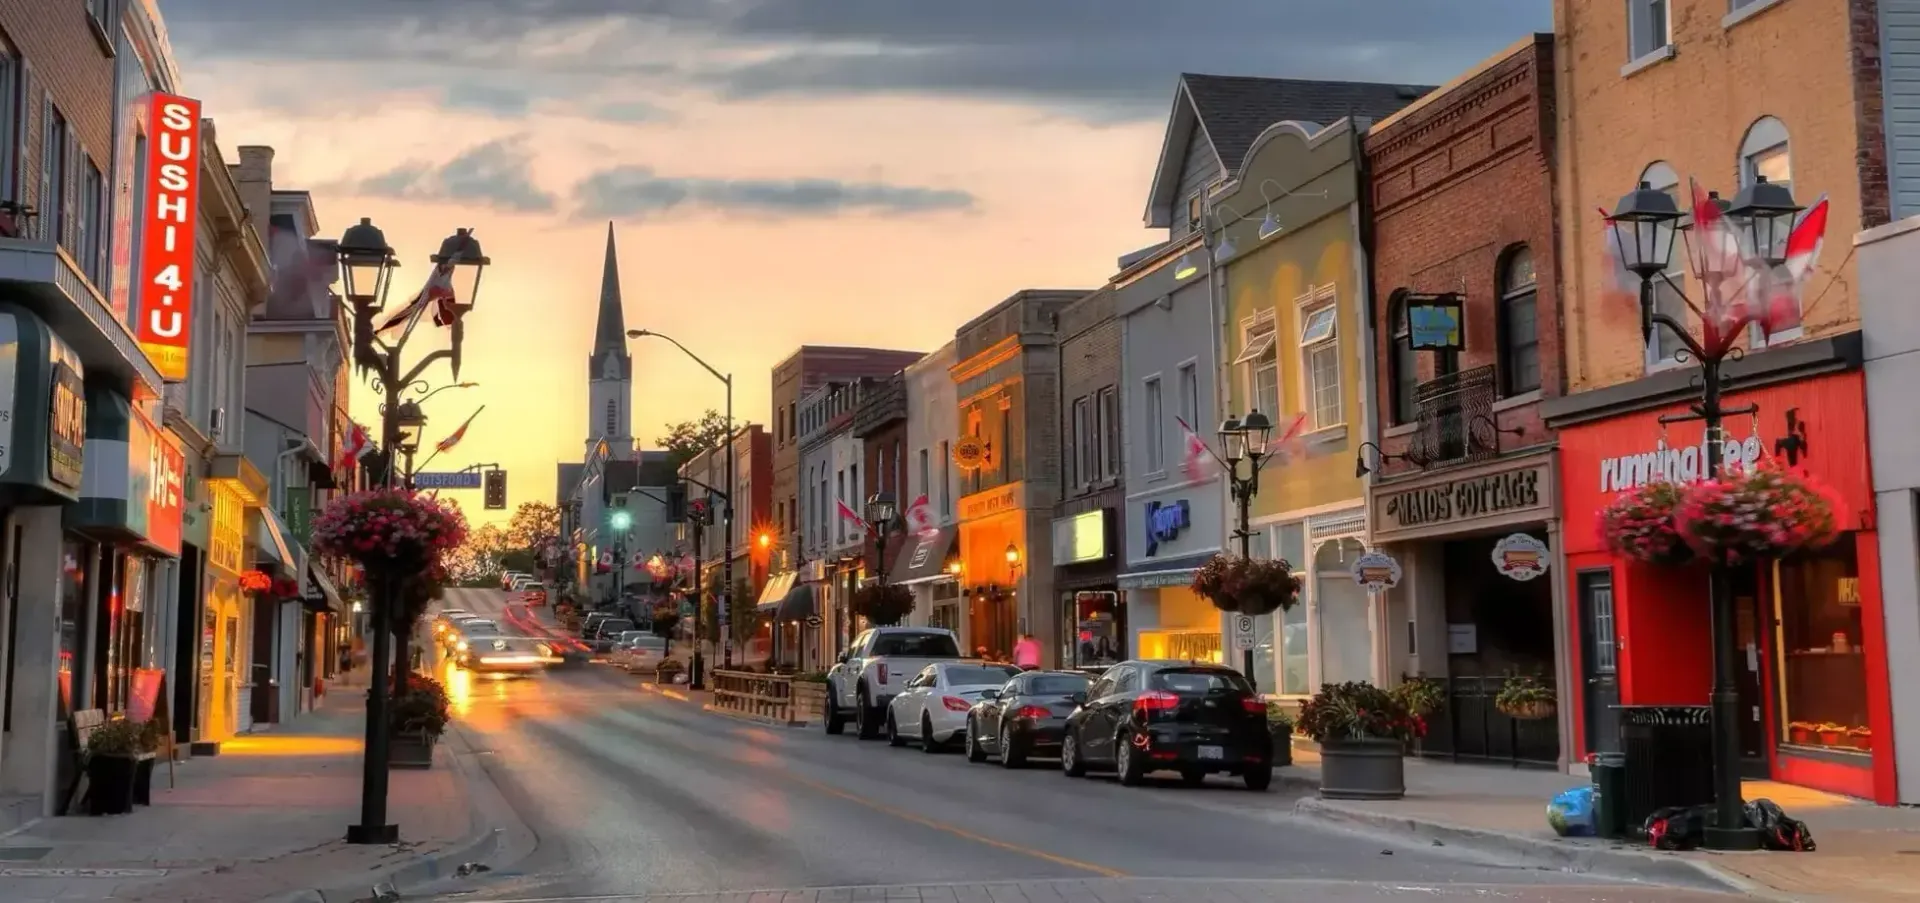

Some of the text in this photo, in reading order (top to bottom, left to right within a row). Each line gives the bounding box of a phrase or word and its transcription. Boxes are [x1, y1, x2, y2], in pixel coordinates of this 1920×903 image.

[158, 103, 192, 252] SUSHI
[415, 474, 471, 487] BOTSFORD
[1455, 470, 1538, 516] COTTAGE
